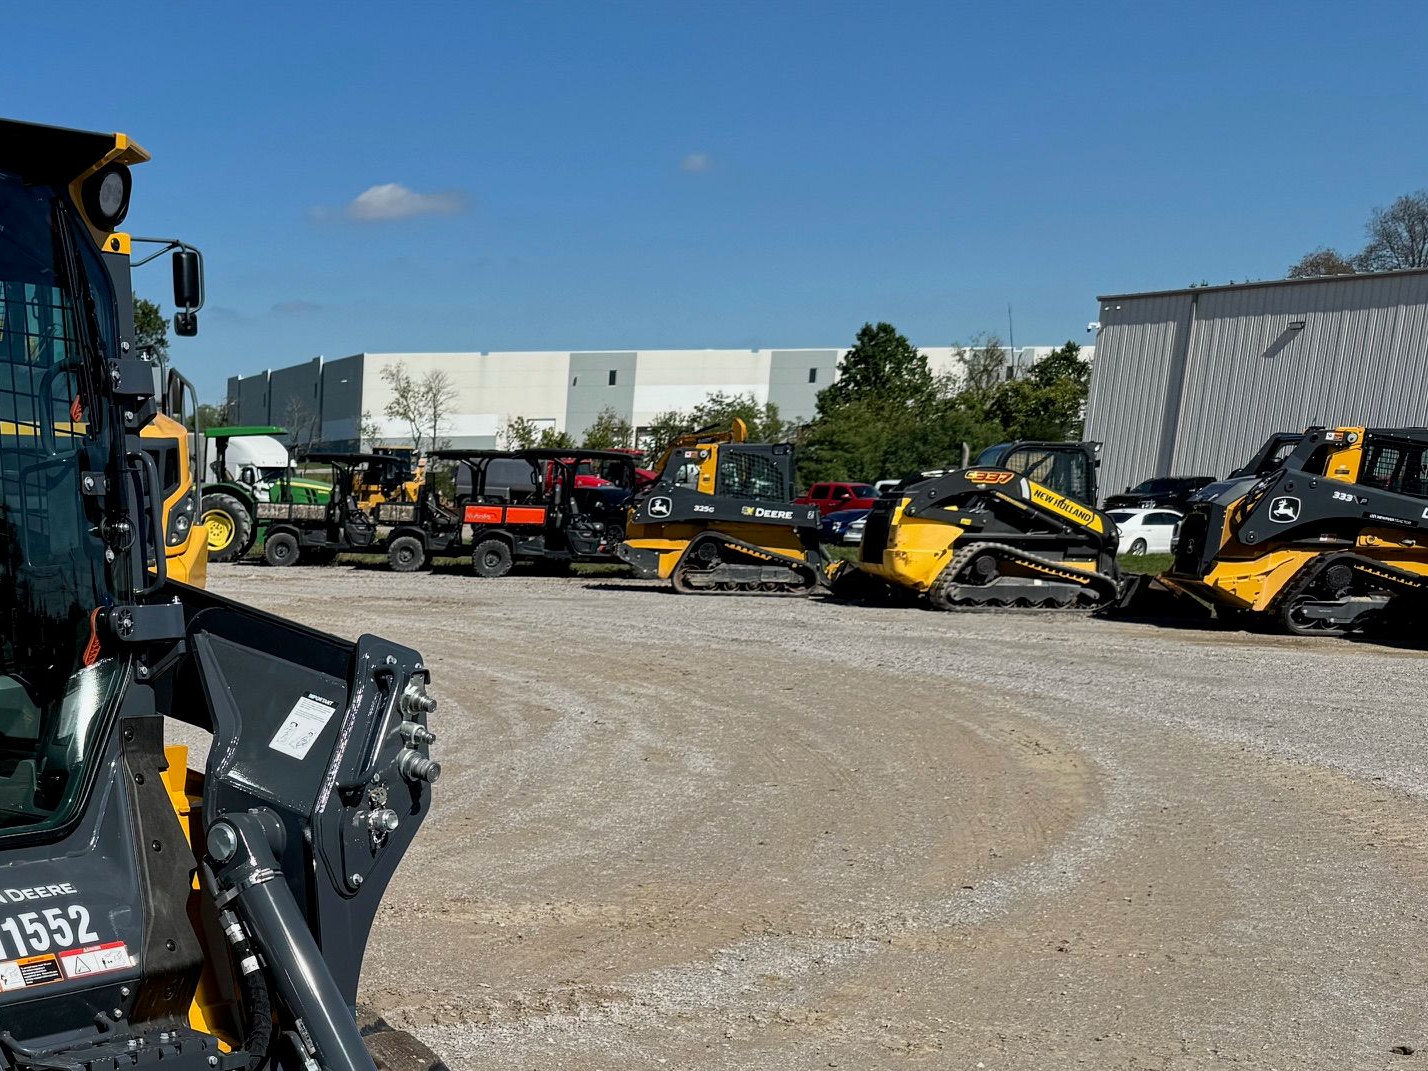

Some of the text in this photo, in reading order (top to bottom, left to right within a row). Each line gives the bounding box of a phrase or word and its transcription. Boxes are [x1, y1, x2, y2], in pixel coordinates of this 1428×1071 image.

[1332, 491, 1353, 502] 333
[755, 507, 793, 520] DEERE
[1033, 489, 1054, 503] NEW
[1054, 498, 1092, 522] HOLLAND
[4, 882, 78, 903] DEERE
